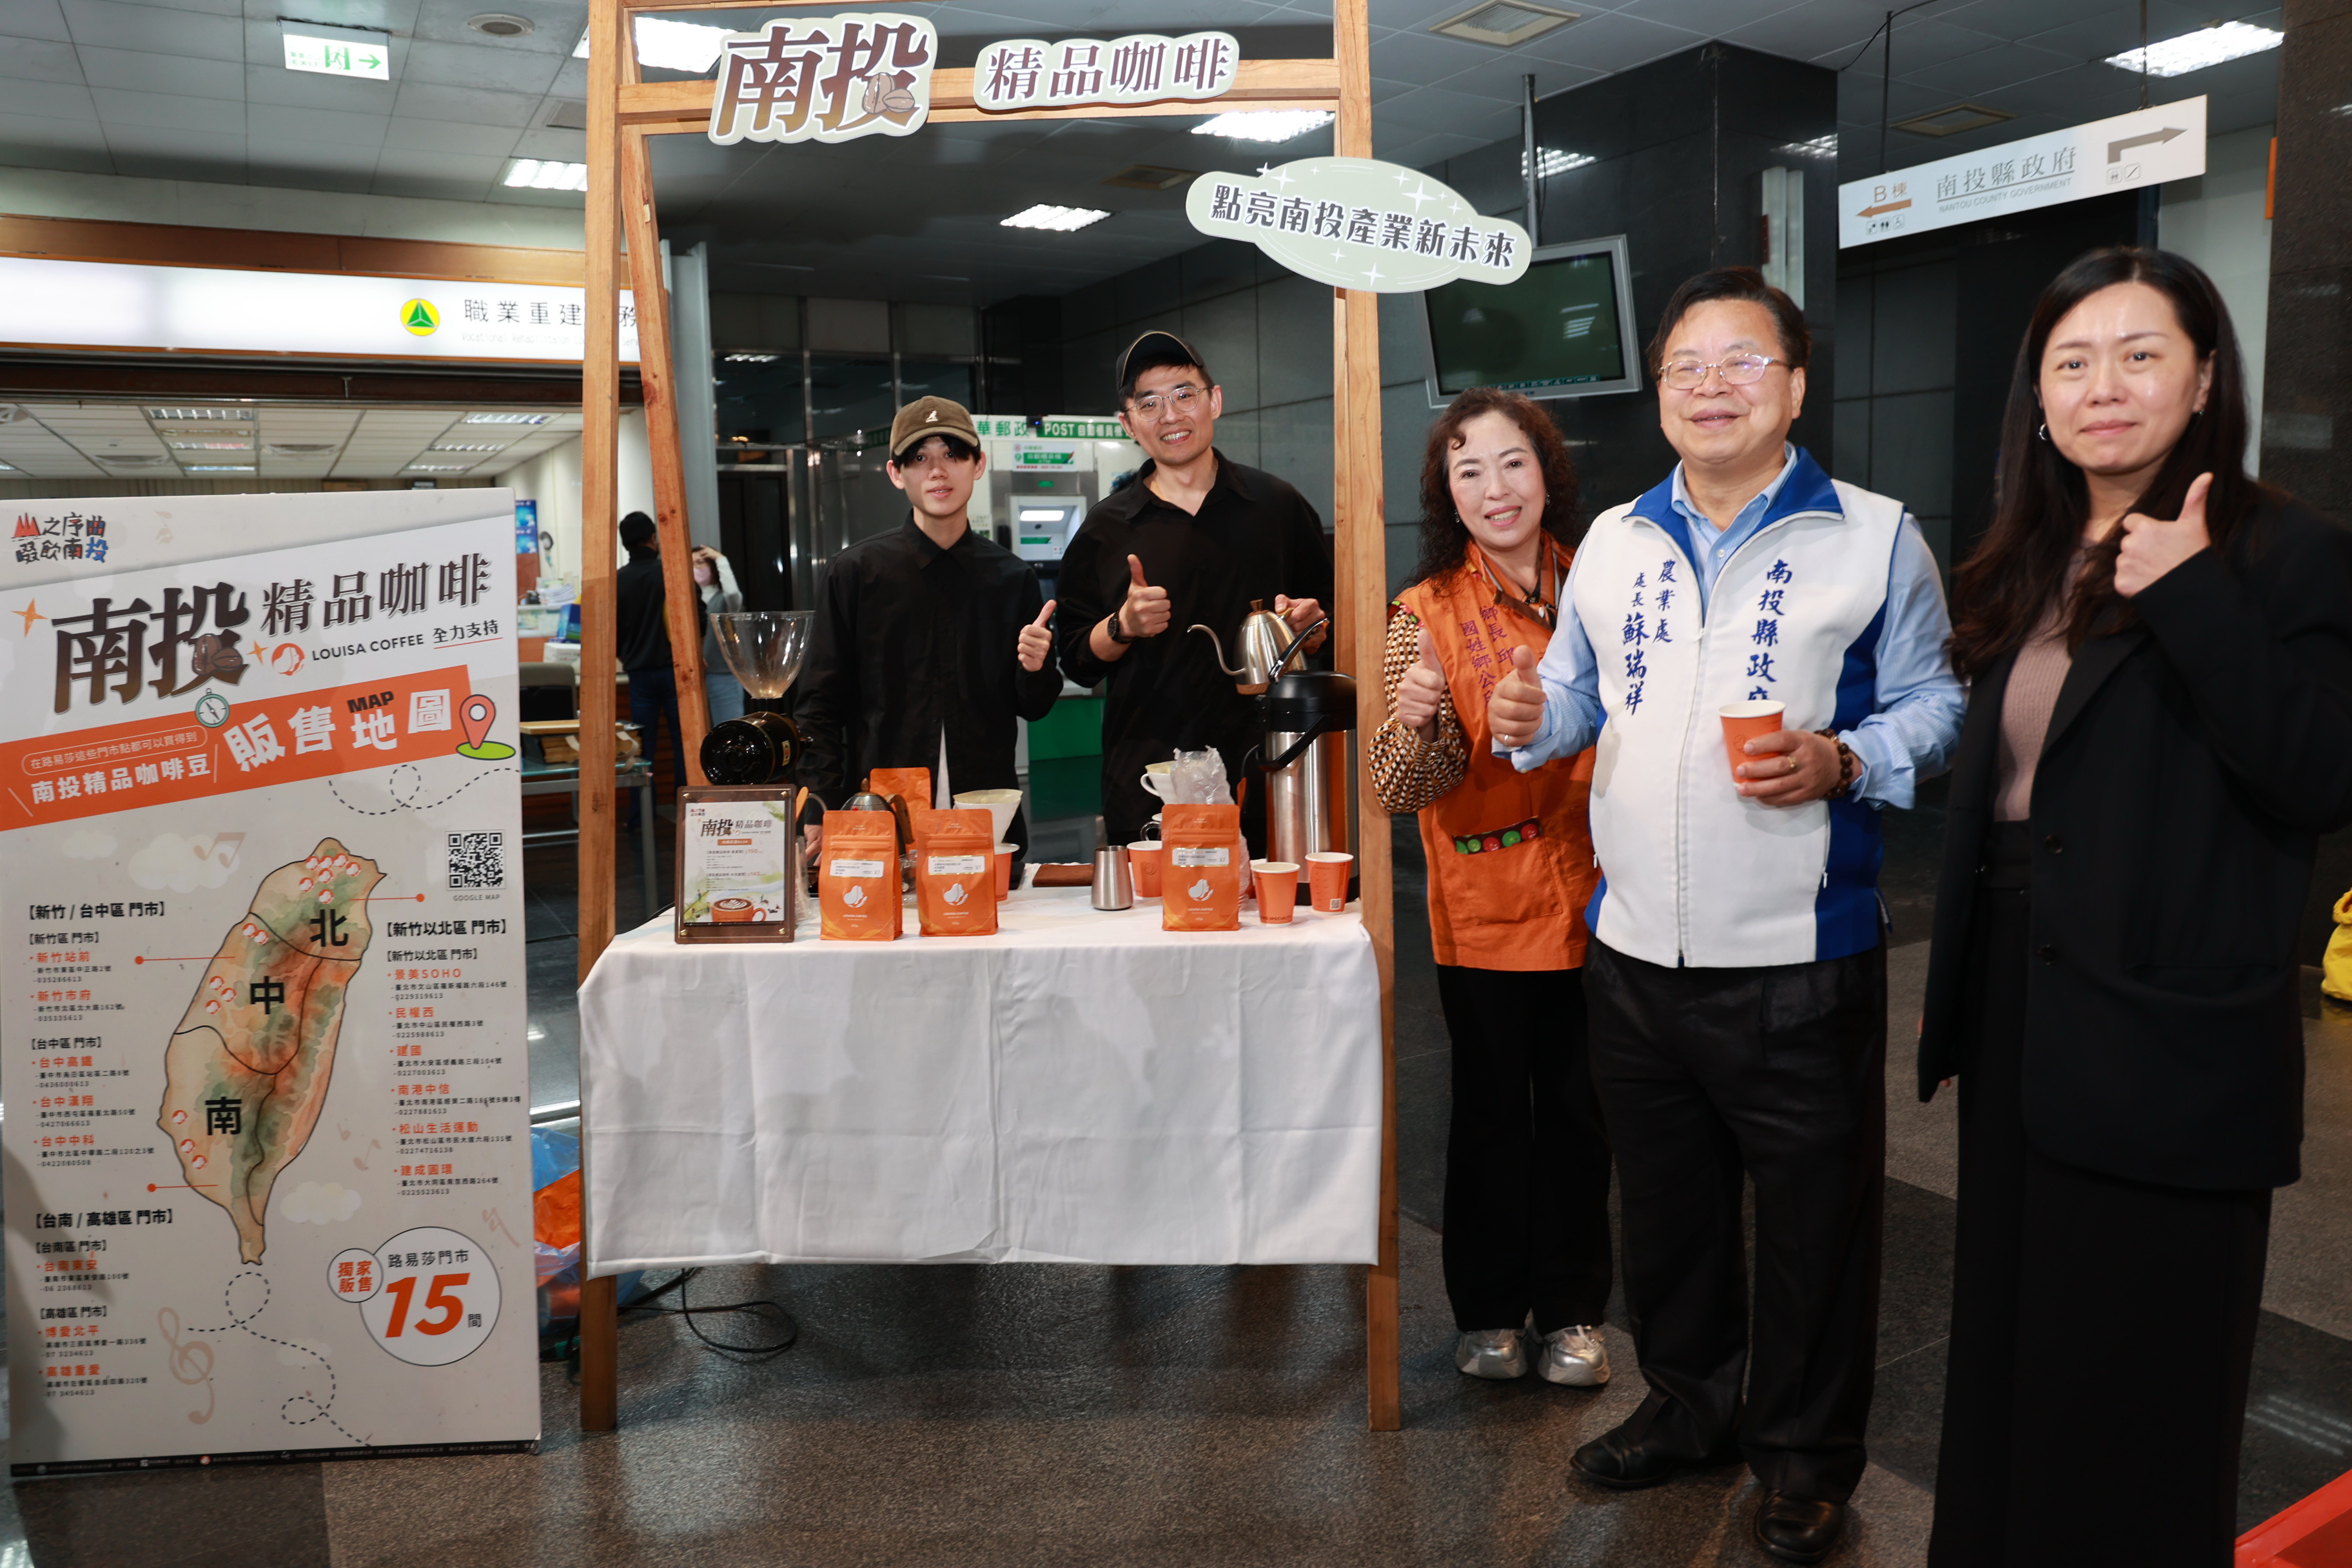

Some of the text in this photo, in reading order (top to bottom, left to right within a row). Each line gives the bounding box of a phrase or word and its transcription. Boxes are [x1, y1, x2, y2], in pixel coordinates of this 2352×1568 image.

[716, 23, 1231, 136] 南投 精品咖啡
[1937, 146, 2077, 199] 南投縣政府
[1939, 177, 2072, 213] NANTOU COUNTY GOVERNMENT
[1210, 184, 1516, 268] 點亮南投產業新未來
[1044, 424, 1075, 436] POST
[1652, 559, 1678, 643] 農業處
[52, 553, 491, 714] 南投 精品咖啡
[311, 620, 499, 662] LOUISA COFFEE 全力支持
[1479, 604, 1516, 674] 鄉長邱
[1622, 611, 1651, 716] 蘇瑞祥
[346, 691, 394, 714] MAP
[224, 688, 452, 772] 販售地圖
[30, 731, 198, 769] 在路易莎這些門市點都可以買得到
[31, 752, 211, 804] 南投精品咖啡豆
[701, 819, 734, 837] 南投
[309, 909, 349, 947] 北
[37, 951, 90, 963] 新竹站前
[395, 968, 462, 980] 景美SOHO
[37, 990, 91, 1001] 新竹市府
[250, 977, 284, 1015] 中
[396, 1006, 434, 1018] 民權西
[397, 1045, 422, 1056] 建國
[39, 1055, 93, 1068] 台中高鐵
[398, 1083, 450, 1095] 南港中信
[41, 1095, 94, 1107] 台中漢翔
[204, 1097, 242, 1136] 南
[399, 1121, 478, 1134] 松山生活運動
[41, 1135, 95, 1147] 台中中科
[44, 1259, 97, 1272] 台南東安
[388, 1249, 469, 1268] 路易莎門市
[338, 1260, 372, 1278] 獨家
[338, 1276, 373, 1293] 販售
[385, 1272, 471, 1338] 15
[467, 1313, 482, 1328] 間
[45, 1325, 100, 1338] 博愛北平
[46, 1364, 101, 1377] 高雄重愛
